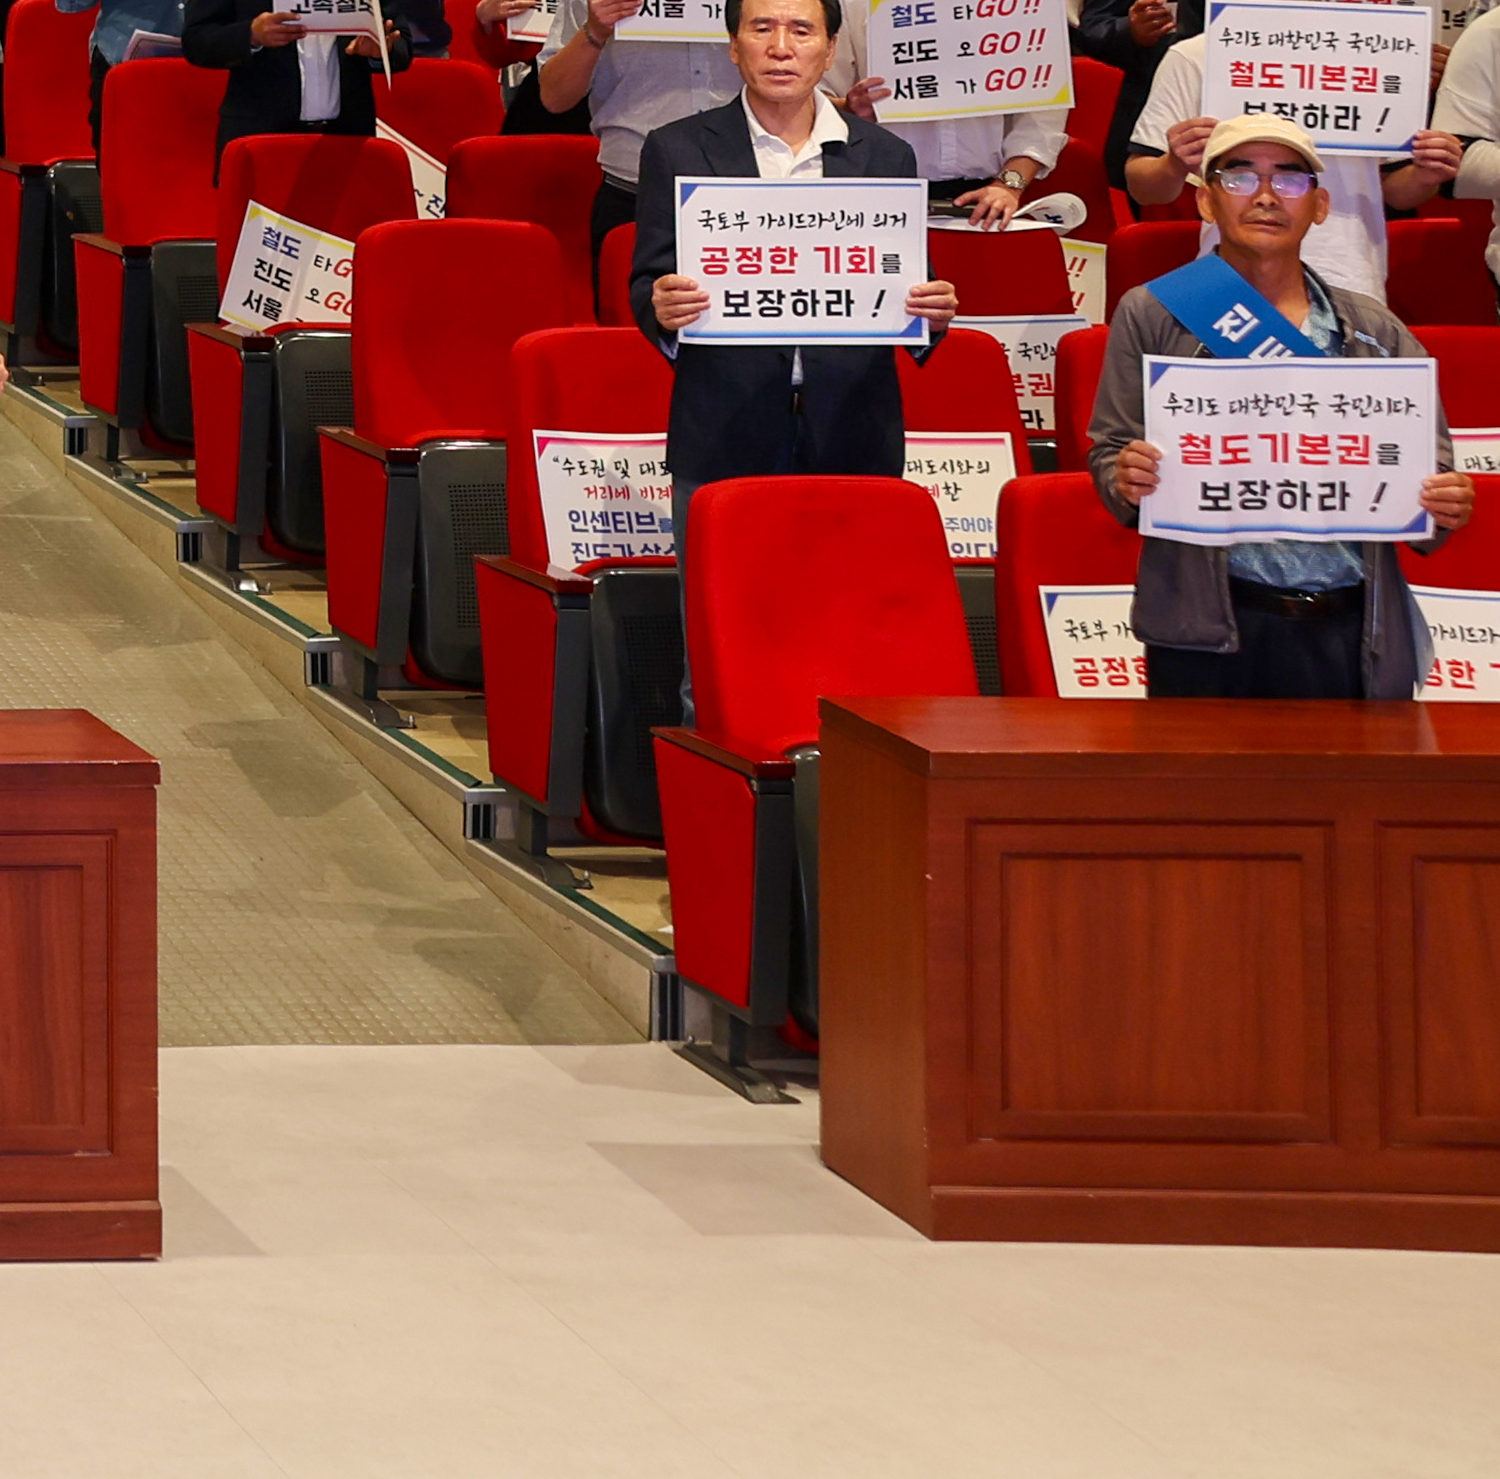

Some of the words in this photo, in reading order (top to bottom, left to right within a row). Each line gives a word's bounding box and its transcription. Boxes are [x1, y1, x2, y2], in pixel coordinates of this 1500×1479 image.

[891, 1, 937, 28] 철도
[892, 38, 939, 65] 진도
[893, 74, 939, 100] 서울
[697, 209, 750, 232] 국토부
[756, 209, 864, 231] 가이드라인에
[872, 212, 907, 228] 의거
[700, 246, 798, 275] 공정한
[813, 245, 901, 274] 기회를
[1162, 392, 1220, 416] 우리도
[1228, 392, 1319, 418] 대한민국
[1328, 393, 1420, 418] 국민이다.
[1178, 432, 1400, 465] 철도기본권을
